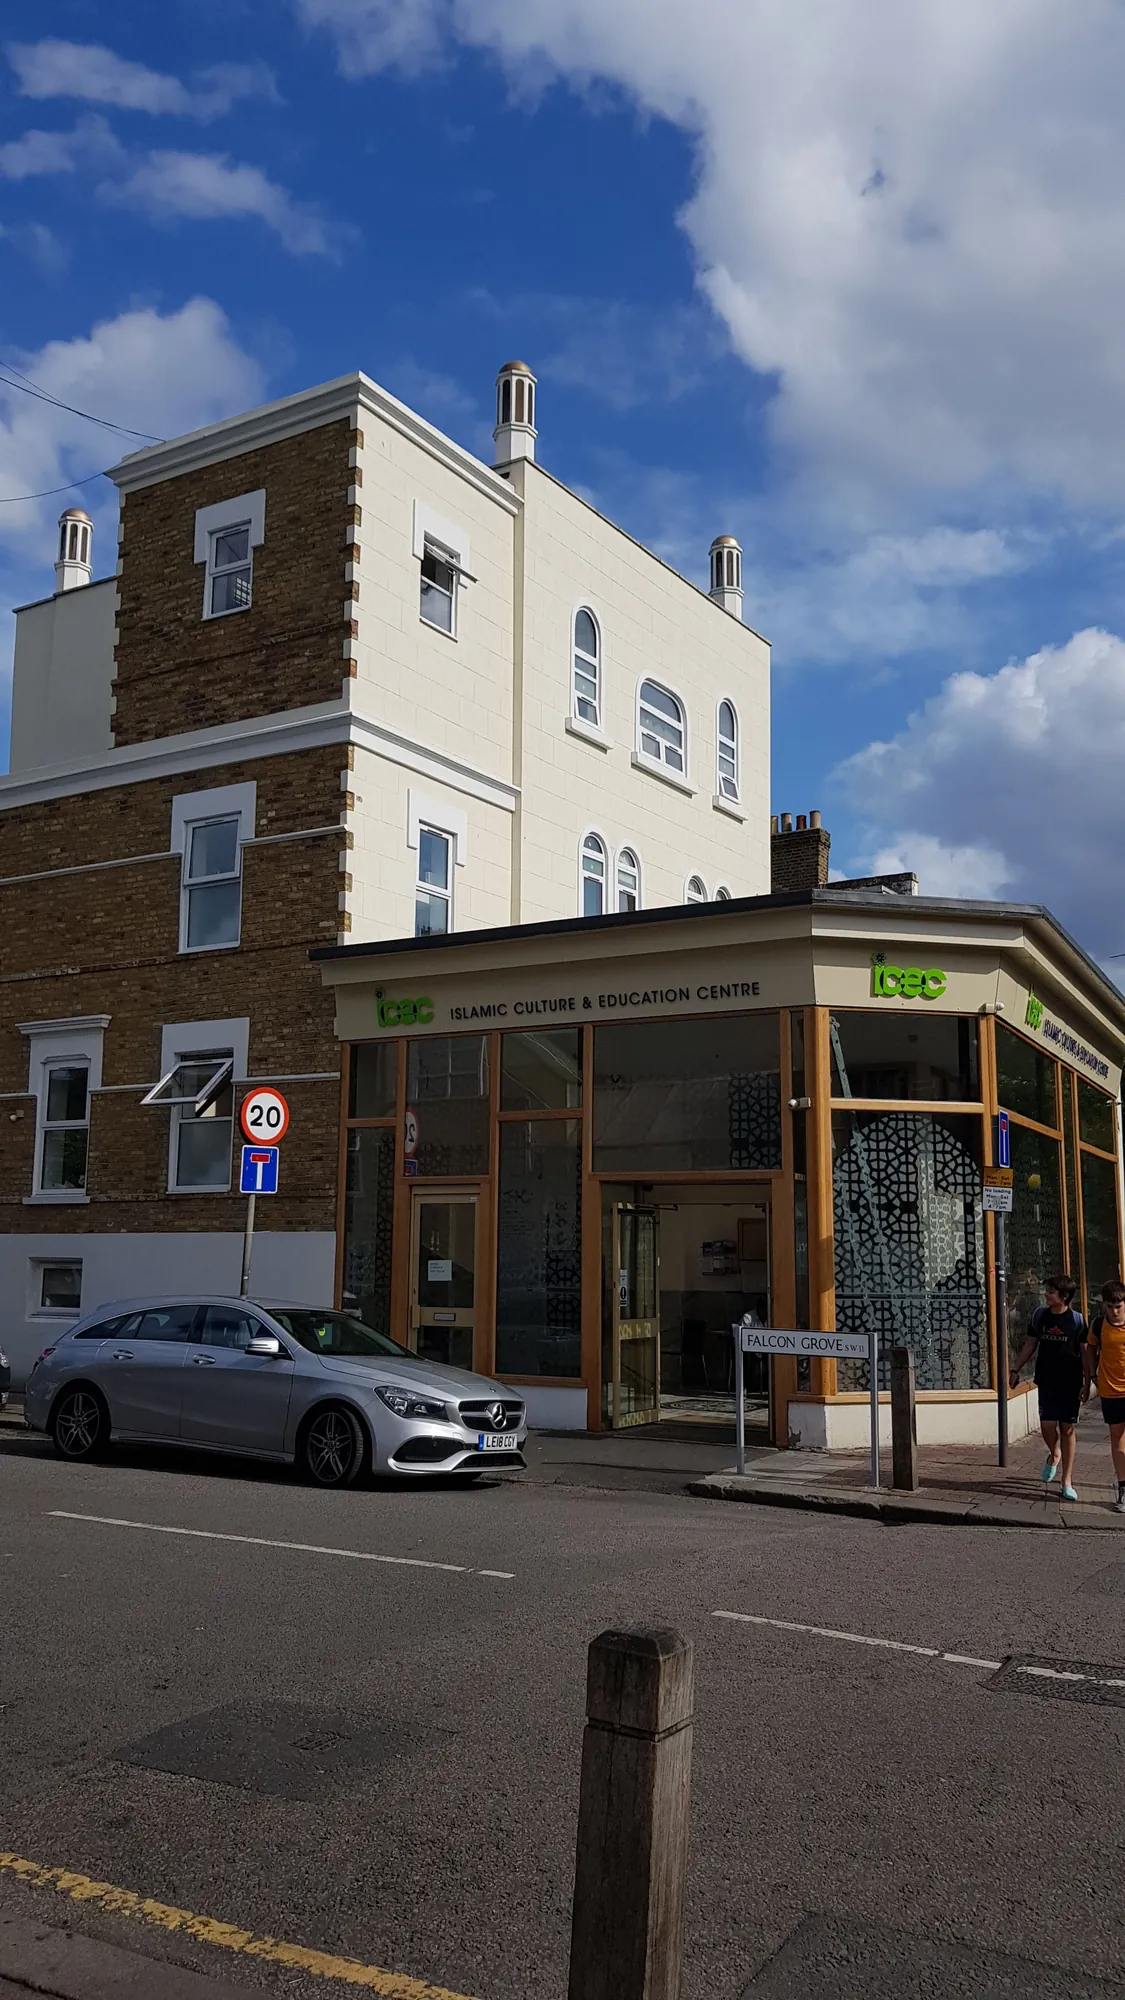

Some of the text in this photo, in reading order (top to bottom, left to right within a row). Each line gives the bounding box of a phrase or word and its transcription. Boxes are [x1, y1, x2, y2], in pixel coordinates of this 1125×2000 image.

[874, 953, 947, 997] icec
[376, 988, 435, 1027] icec
[450, 982, 760, 1020] ISLAMIC CULTURE & EDUCATION CENTRE
[250, 1105, 280, 1128] 20
[747, 1334, 796, 1348] FALCON
[801, 1337, 843, 1351] GROVE
